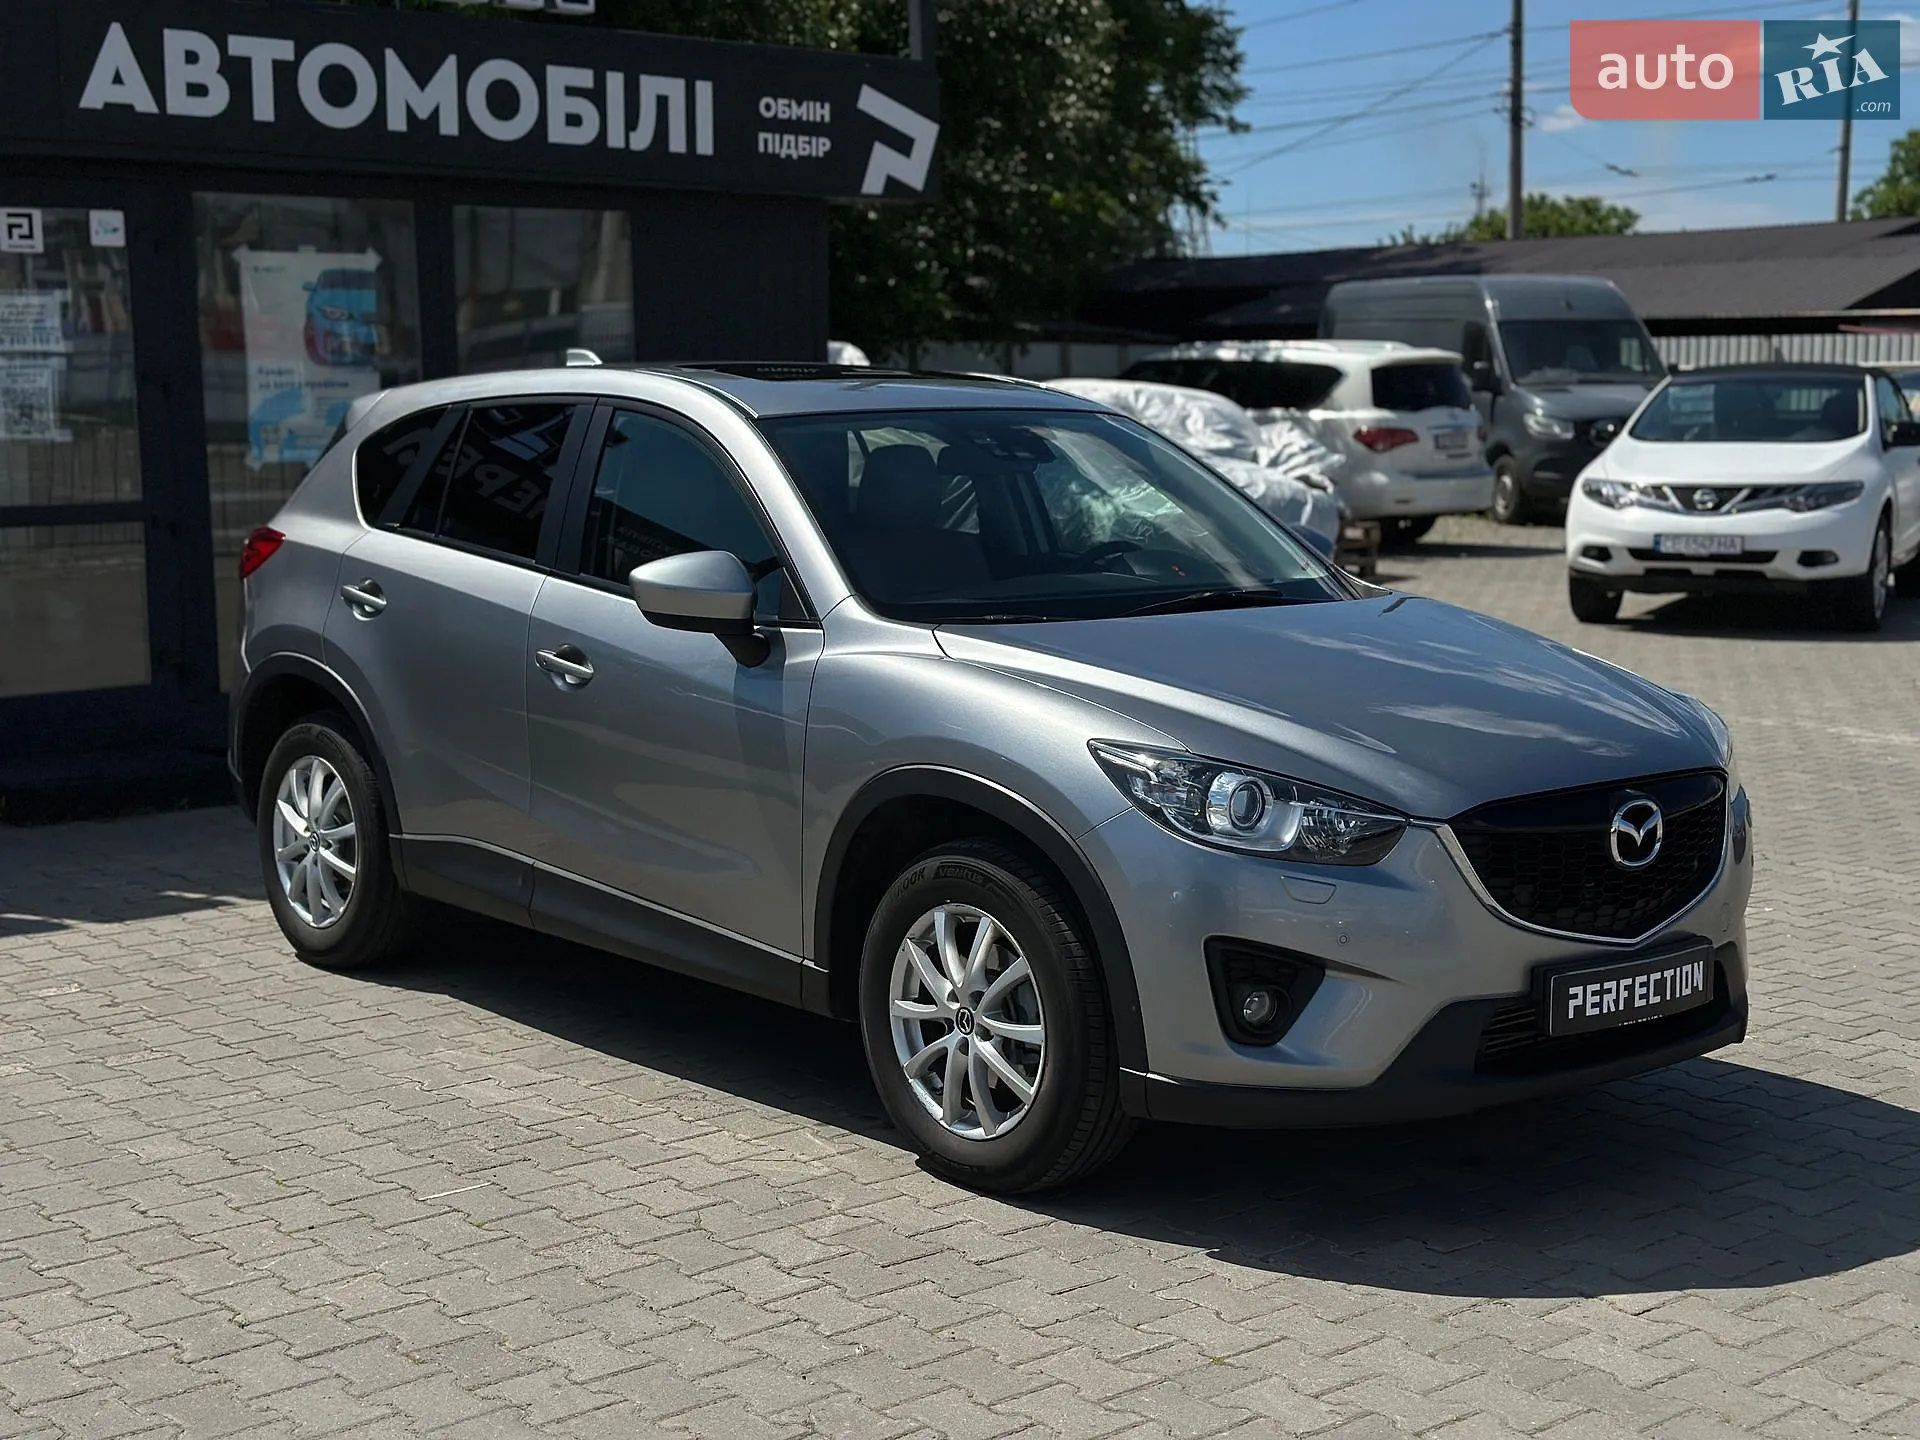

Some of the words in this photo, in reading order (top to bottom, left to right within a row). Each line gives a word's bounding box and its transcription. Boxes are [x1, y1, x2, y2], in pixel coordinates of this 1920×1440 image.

[78, 21, 714, 156] АВТОМОБІЛІ
[759, 96, 831, 123] ОБМІН
[758, 132, 832, 160] ПІДБІР
[1568, 960, 1705, 1019] PERFECTION
